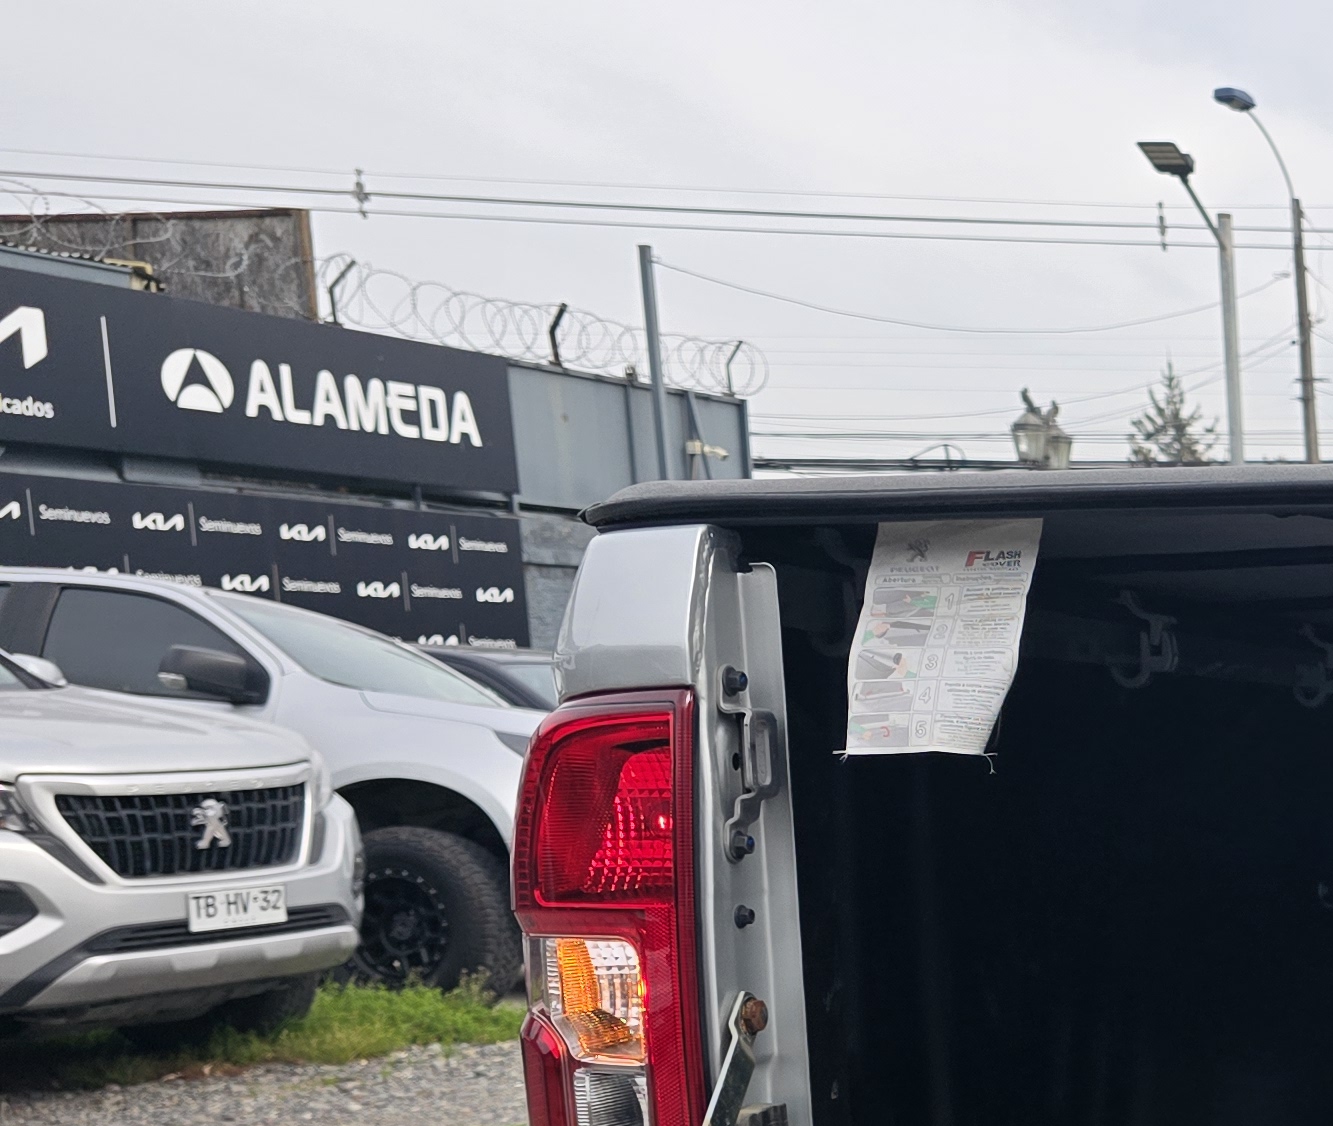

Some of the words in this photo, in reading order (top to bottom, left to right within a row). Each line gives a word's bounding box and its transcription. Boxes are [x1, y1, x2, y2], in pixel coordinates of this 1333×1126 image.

[0, 392, 54, 418] cados
[245, 358, 483, 447] ALAMEDA
[39, 504, 111, 525] Seminuevos
[132, 512, 185, 531] KIA
[279, 523, 326, 542] KIA
[408, 533, 449, 550] KIA
[965, 550, 1022, 567] FLASH
[221, 573, 270, 591] KIA
[357, 581, 400, 597] KIA
[476, 587, 514, 602] KIA
[933, 624, 948, 640] 2
[925, 654, 938, 671] 3
[919, 687, 931, 704] 4
